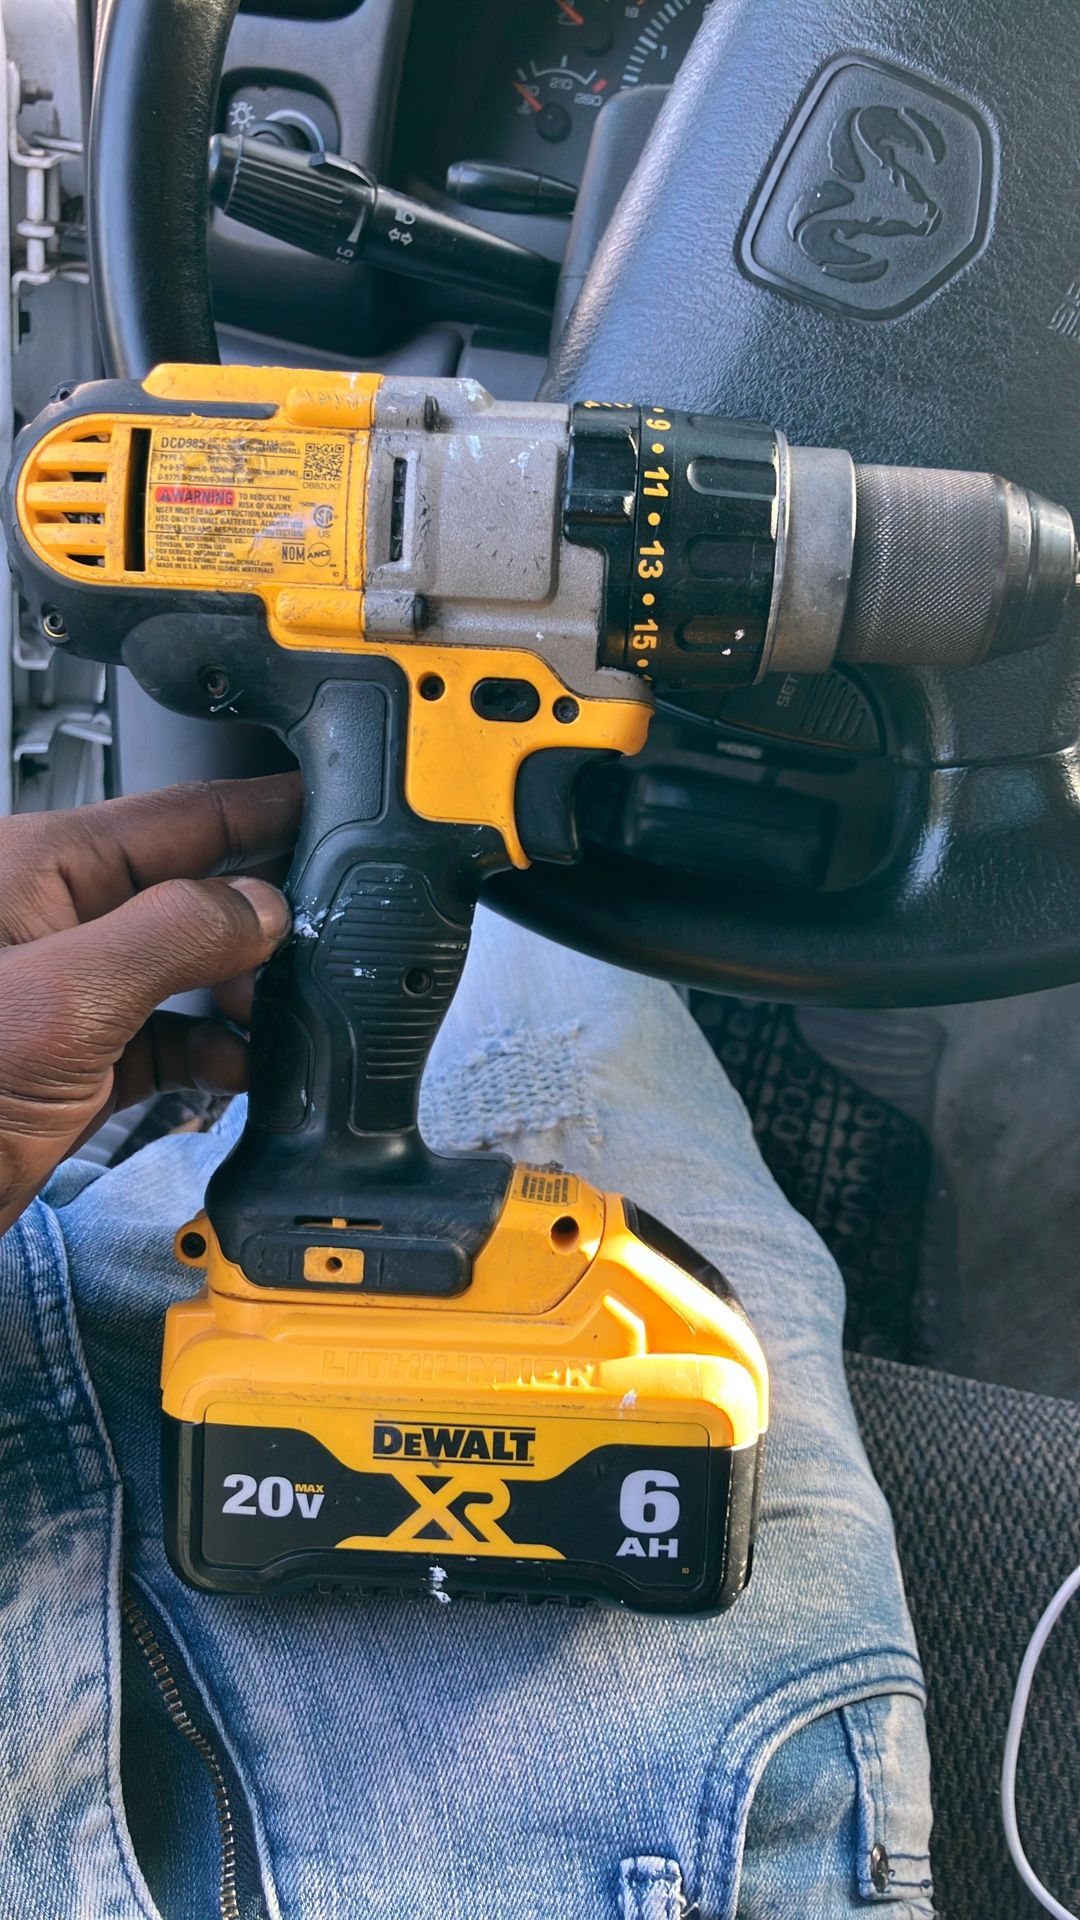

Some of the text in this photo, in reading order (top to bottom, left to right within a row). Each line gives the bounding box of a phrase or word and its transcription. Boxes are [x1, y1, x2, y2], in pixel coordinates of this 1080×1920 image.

[646, 418, 671, 430] 9
[161, 437, 207, 449] DCD985
[643, 466, 670, 497] 11
[173, 489, 233, 505] WARNING
[282, 545, 306, 561] NOM
[307, 549, 332, 560] ANCE
[638, 540, 665, 579] 13
[631, 618, 659, 650] 15
[776, 673, 800, 707] SET
[321, 1350, 507, 1384] LITHIUM
[294, 1483, 325, 1493] MAX
[619, 1469, 680, 1534] 6
[615, 1537, 679, 1559] AH
